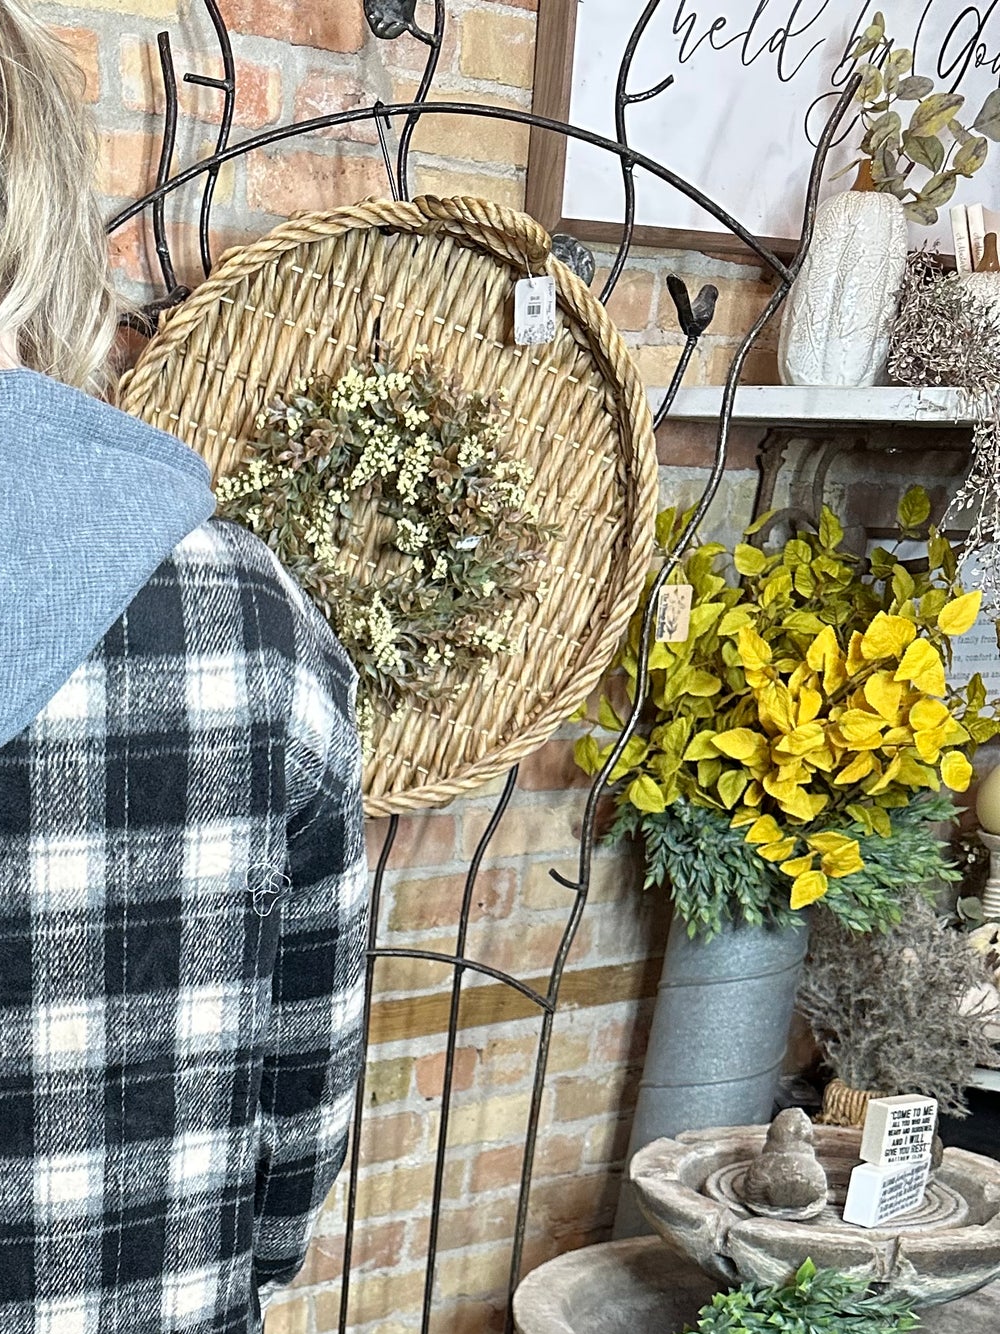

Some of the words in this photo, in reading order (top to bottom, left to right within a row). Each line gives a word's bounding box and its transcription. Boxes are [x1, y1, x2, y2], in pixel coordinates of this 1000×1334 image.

[913, 1108, 921, 1117] TO
[892, 1138, 903, 1146] AND
[909, 1134, 924, 1144] WILL
[884, 1147, 898, 1157] GIVE
[899, 1146, 910, 1155] YOU
